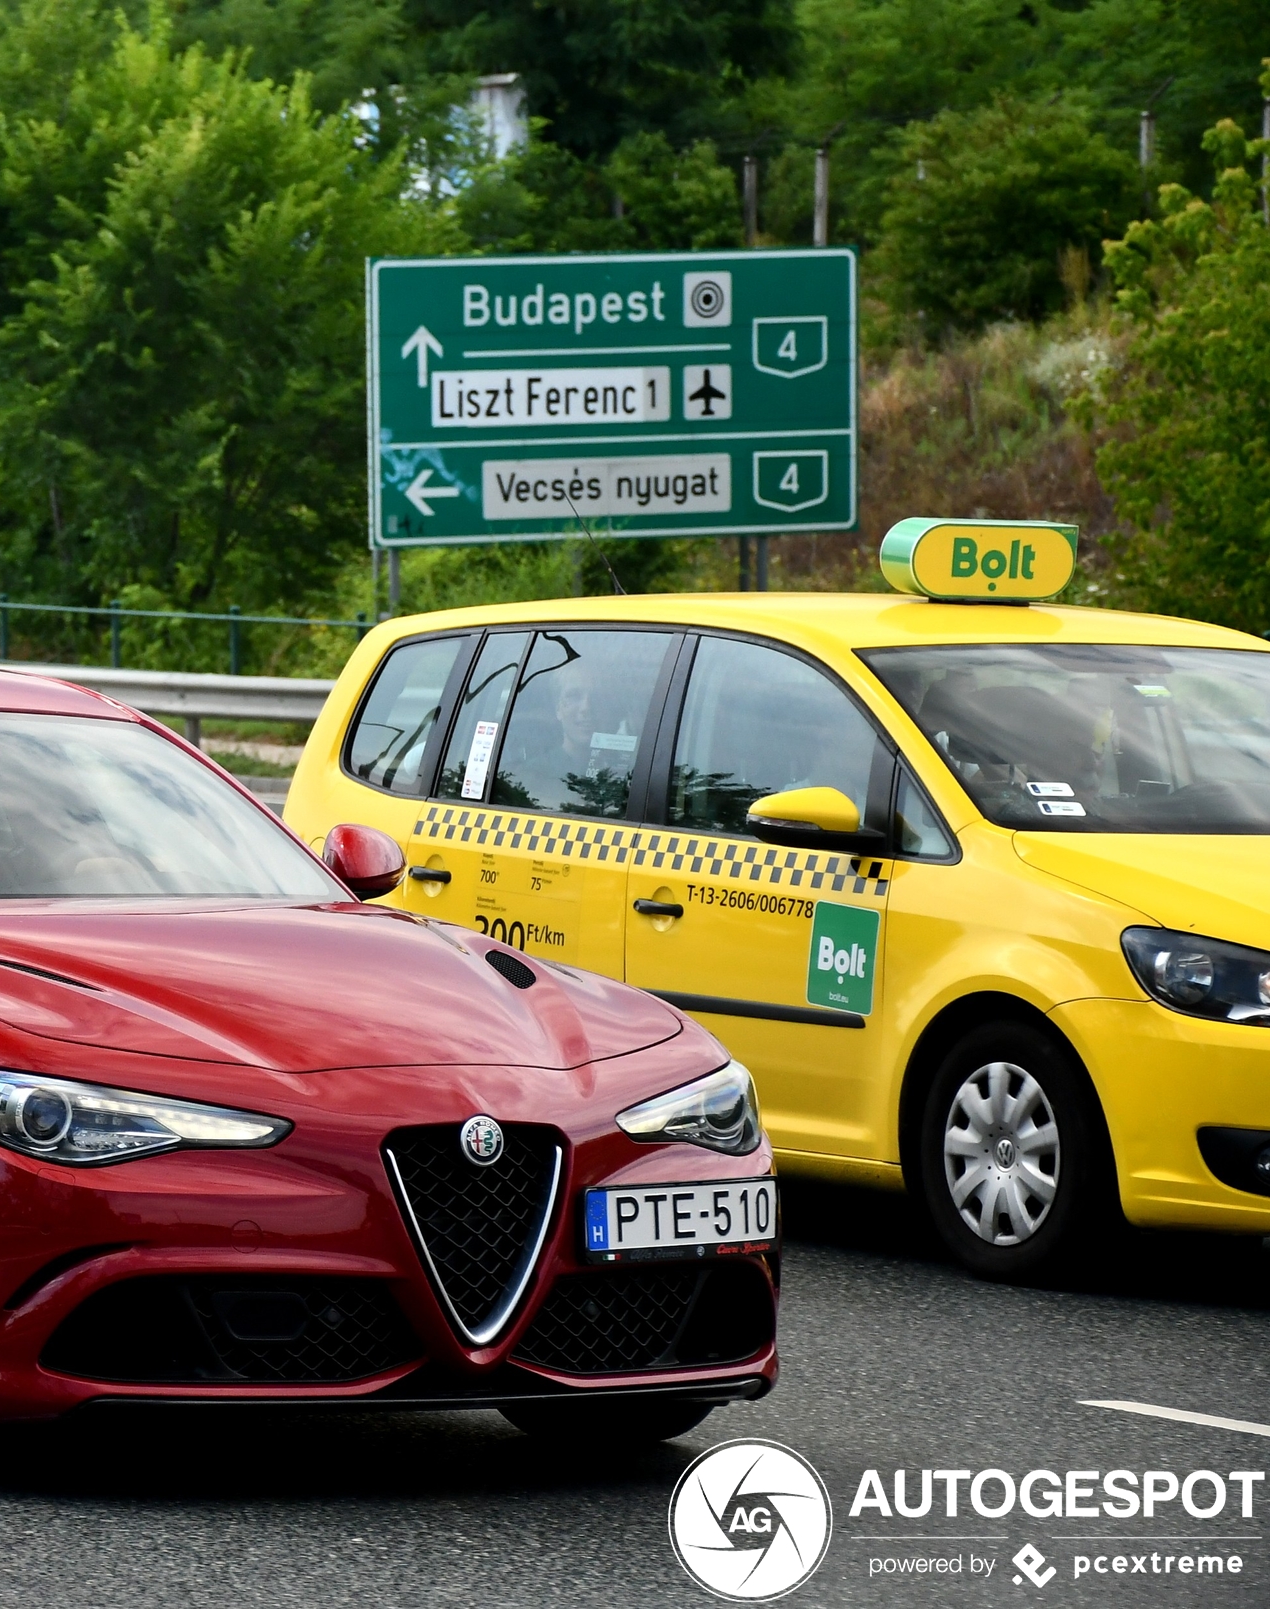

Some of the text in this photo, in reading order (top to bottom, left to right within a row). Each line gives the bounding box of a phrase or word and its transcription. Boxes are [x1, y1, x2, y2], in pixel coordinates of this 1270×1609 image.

[463, 282, 666, 335] Budapest
[777, 330, 798, 362] 4
[439, 376, 657, 419] Liszt Ferenc 1
[496, 467, 719, 506] Vecsés nyugat
[779, 462, 800, 494] 4
[951, 537, 1036, 591] Bolt
[480, 869, 497, 884] 700
[531, 877, 542, 890] 75
[687, 884, 814, 918] T-13-2606/006778
[527, 923, 565, 946] Ft/km
[817, 935, 867, 985] Bolt
[592, 1187, 770, 1243] H PTE-510
